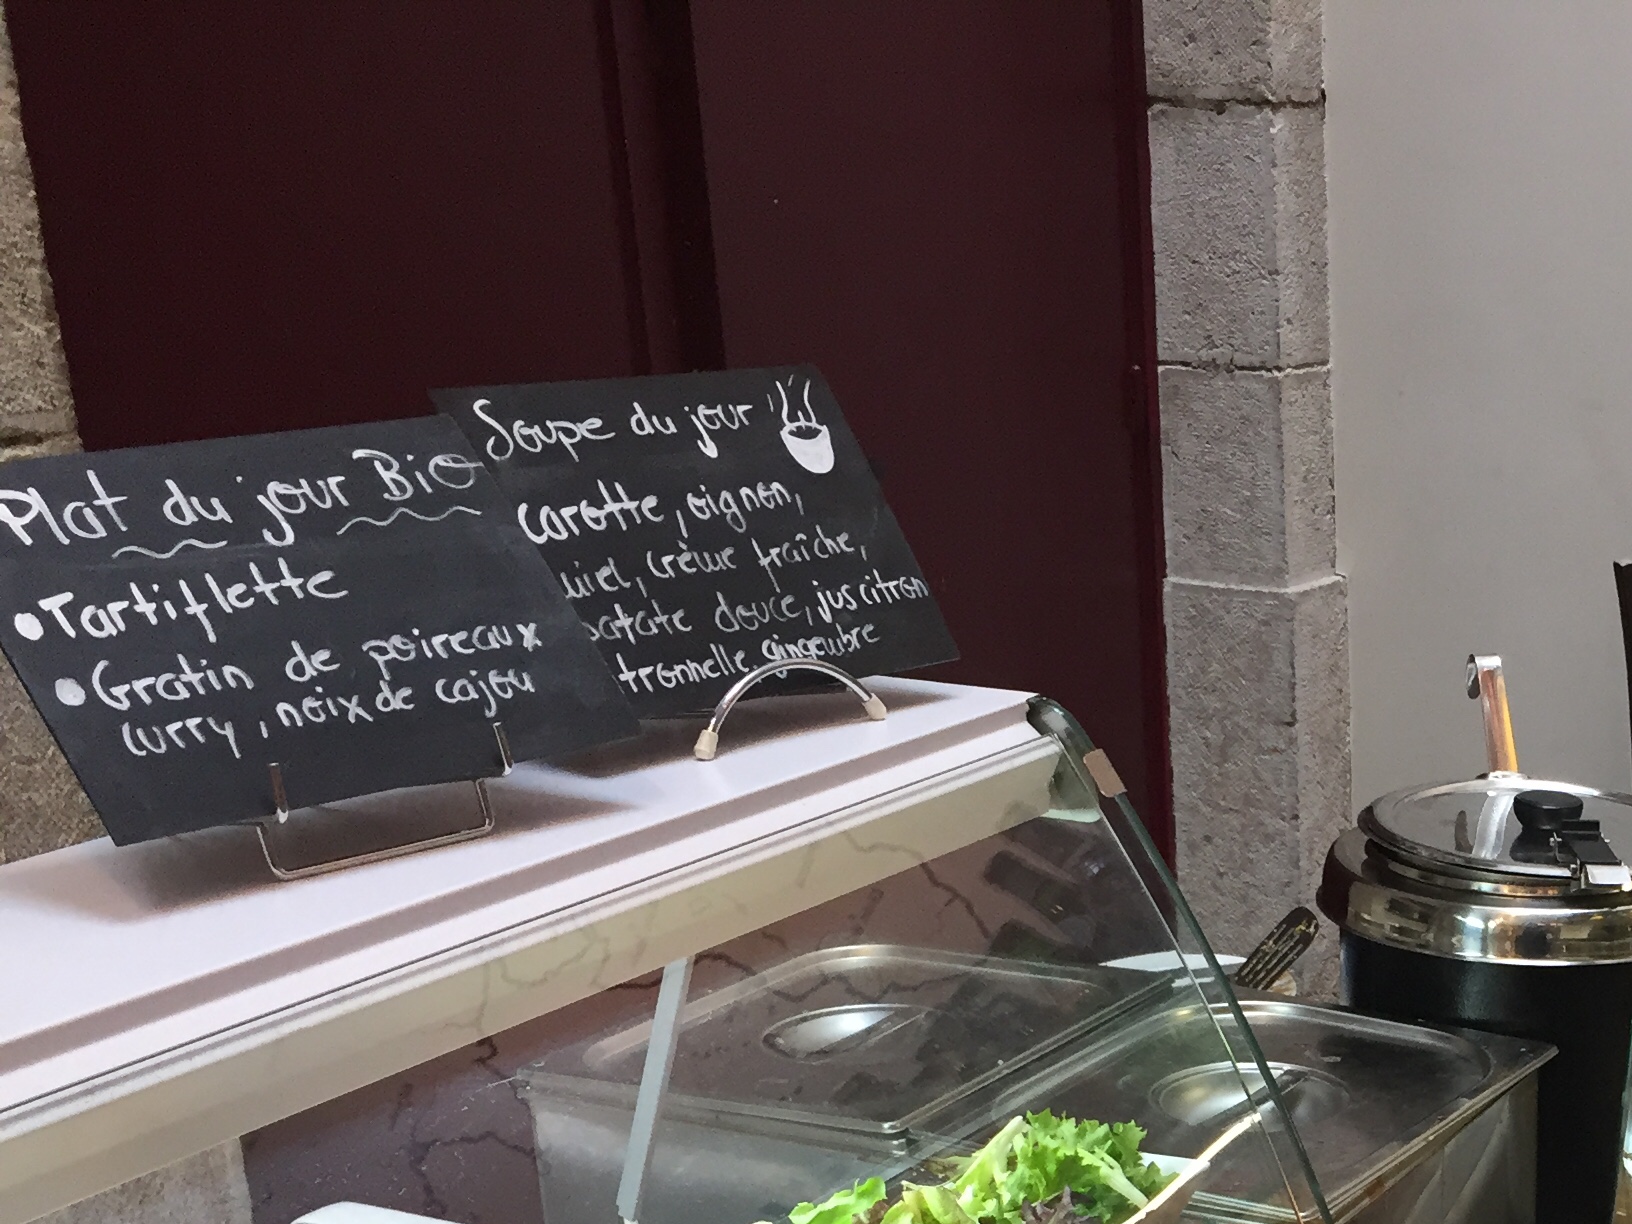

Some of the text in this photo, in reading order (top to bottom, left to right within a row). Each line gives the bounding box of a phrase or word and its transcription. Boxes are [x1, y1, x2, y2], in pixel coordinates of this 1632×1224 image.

[472, 399, 754, 463] Soupe du jour
[0, 470, 127, 546] Plat
[162, 478, 233, 527] du
[235, 475, 349, 547] jour
[38, 557, 350, 643] Tartiflette
[812, 580, 859, 623] jus
[858, 569, 930, 609] citron
[92, 621, 543, 712] Gratin de poireaux
[275, 686, 374, 729] noix
[375, 682, 416, 714] de
[435, 668, 536, 719] cajou
